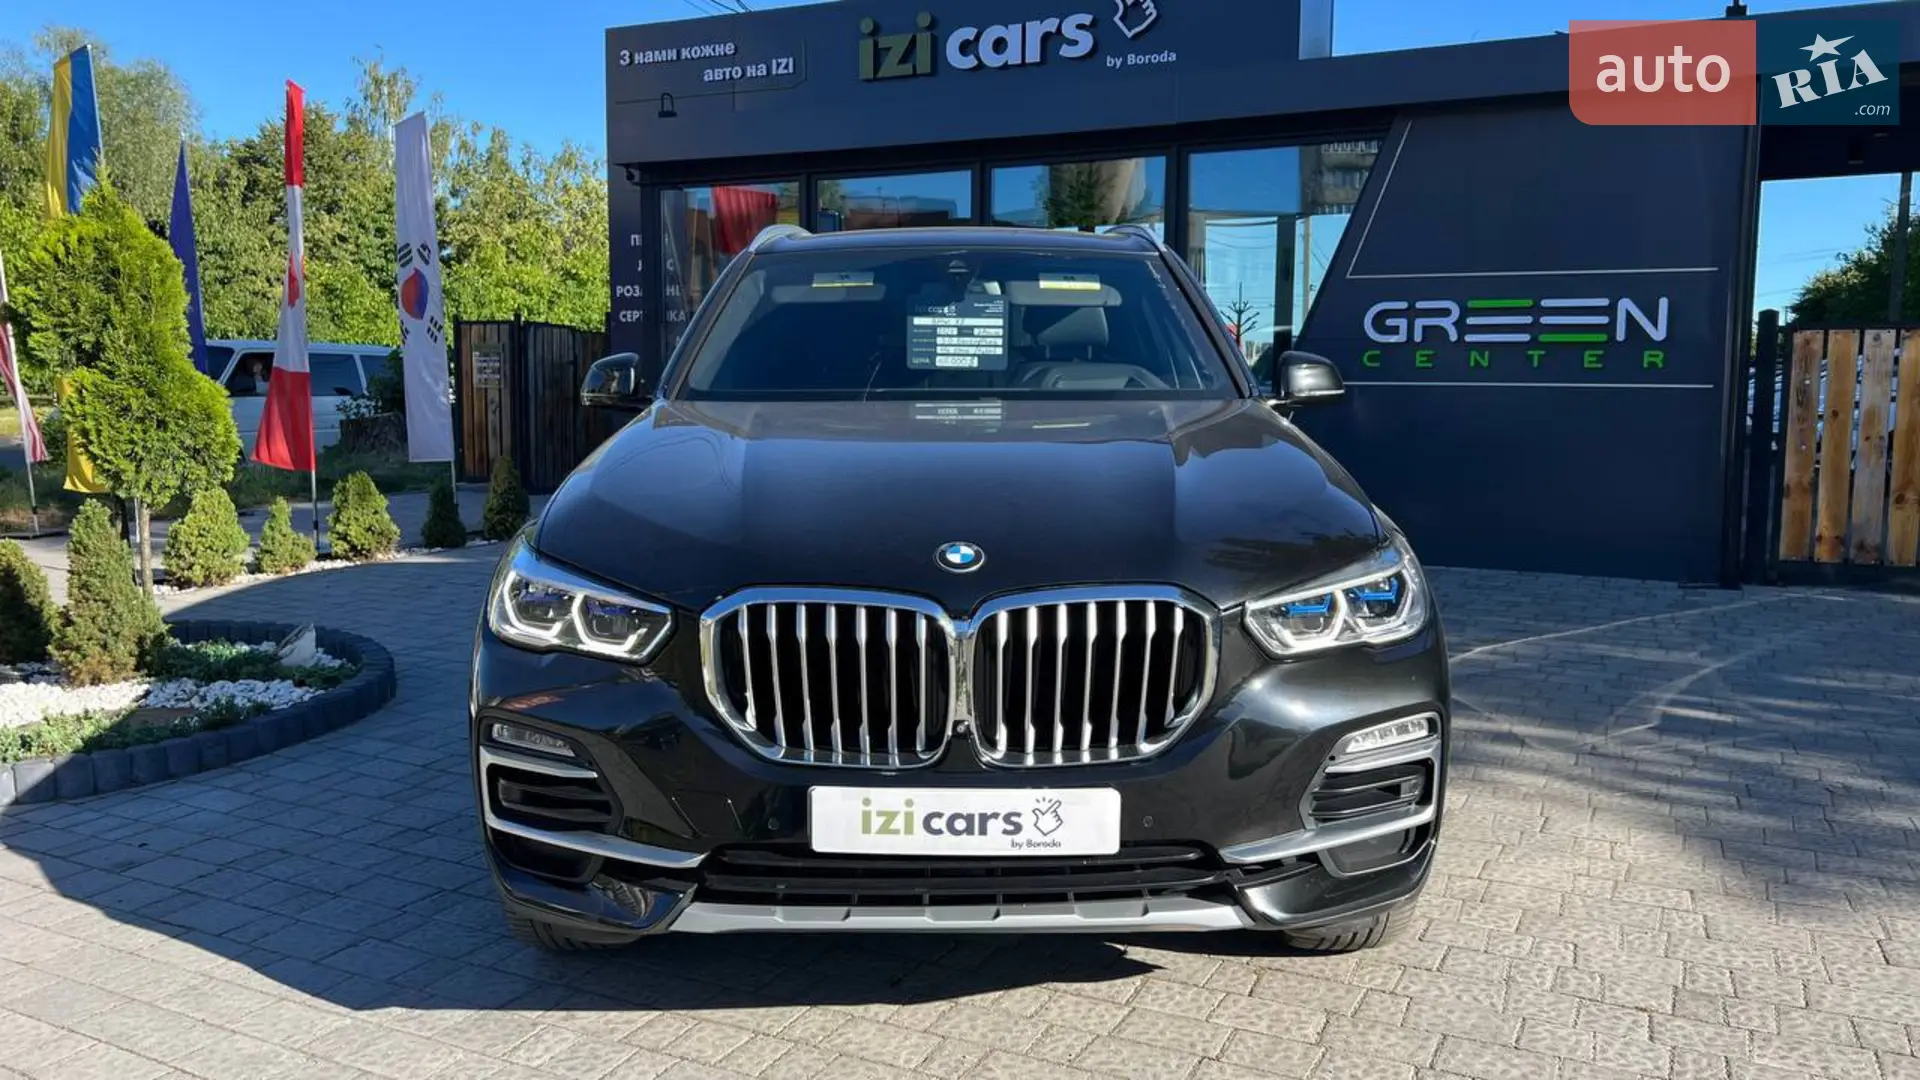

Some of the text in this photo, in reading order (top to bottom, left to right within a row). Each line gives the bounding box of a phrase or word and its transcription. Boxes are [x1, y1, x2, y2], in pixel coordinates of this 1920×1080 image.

[619, 41, 736, 66] З нами кожне
[859, 10, 1095, 80] izi cars
[703, 57, 794, 82] авто на IZI
[1106, 50, 1177, 69] by Boroda
[1363, 296, 1669, 343] GREEN
[1362, 350, 1665, 369] CENTER
[861, 797, 1024, 837] izi cars
[1010, 838, 1062, 850] by Boroda
